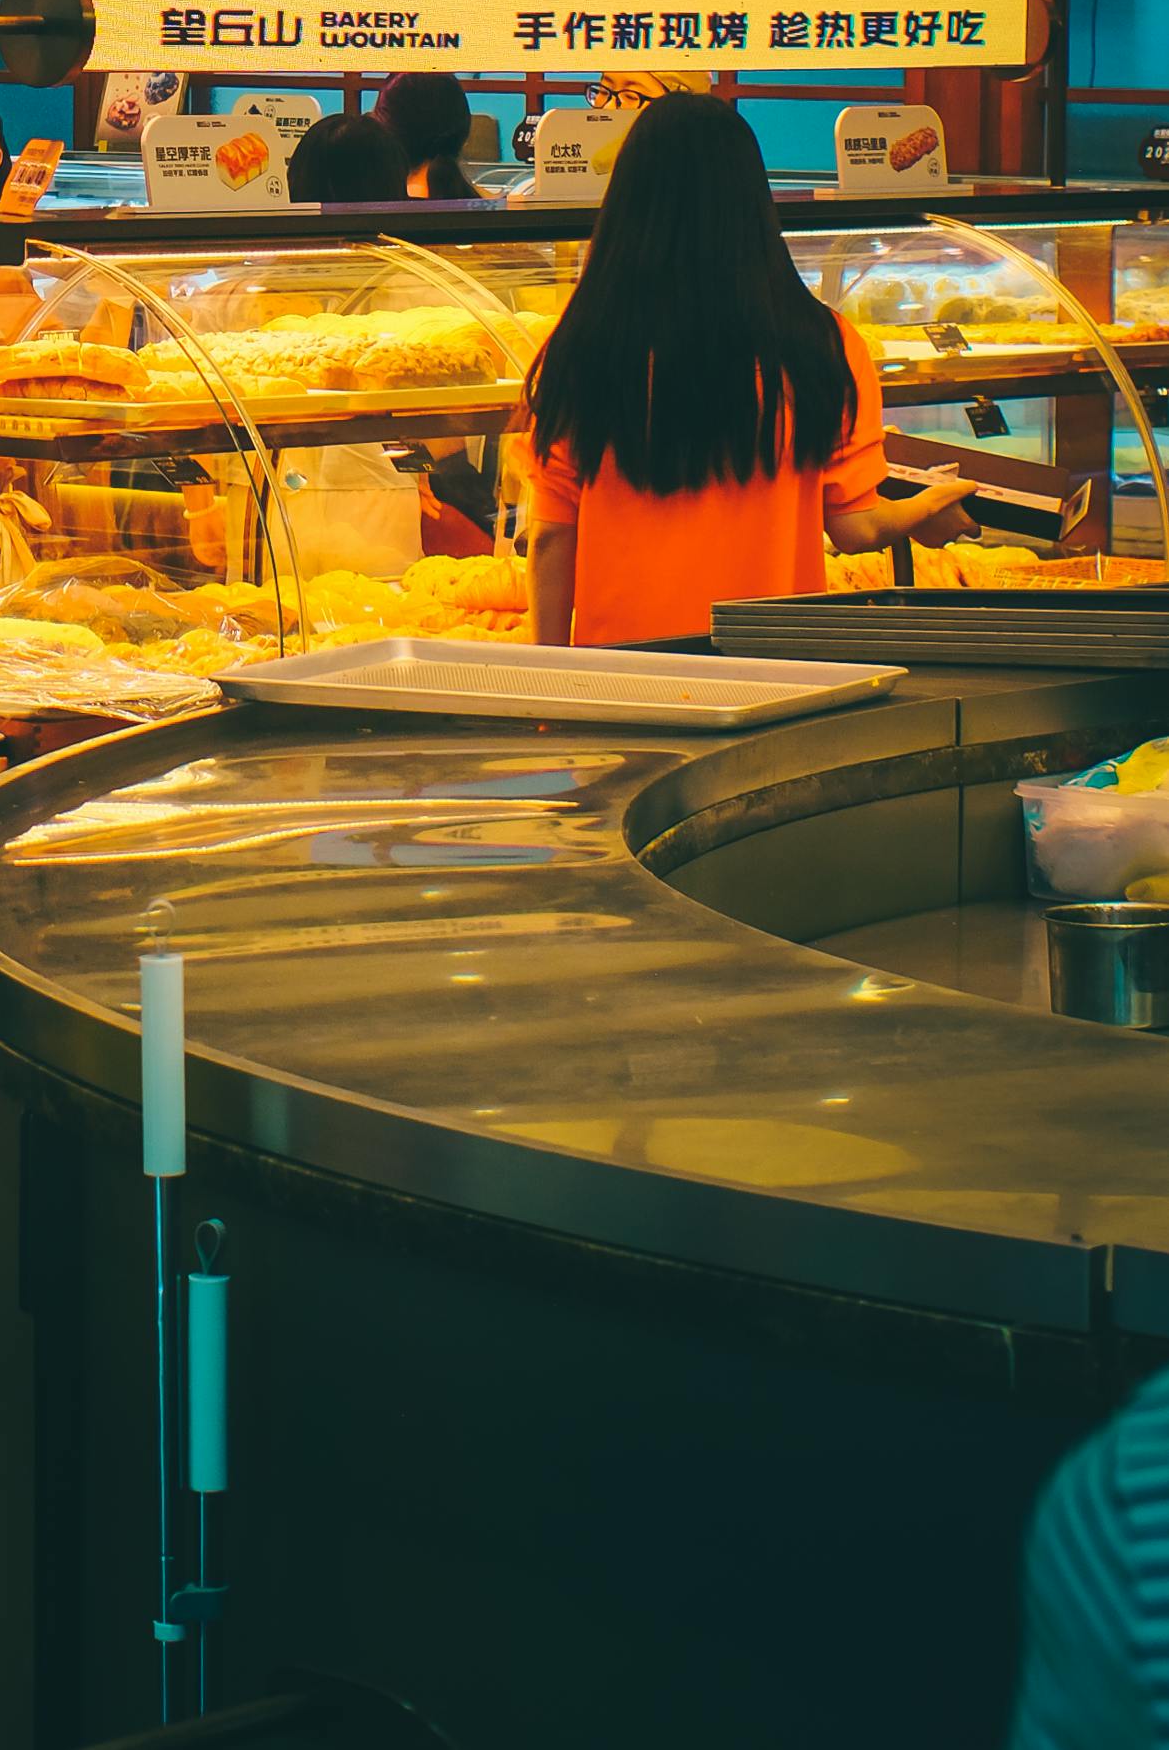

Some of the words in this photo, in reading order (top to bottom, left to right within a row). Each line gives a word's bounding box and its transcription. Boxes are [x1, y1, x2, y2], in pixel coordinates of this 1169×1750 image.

[320, 11, 420, 29] BAKERY
[514, 11, 750, 51] 手作新现烤
[769, 10, 987, 50] 趁热更好吃
[320, 32, 461, 49] WOUNTAIN
